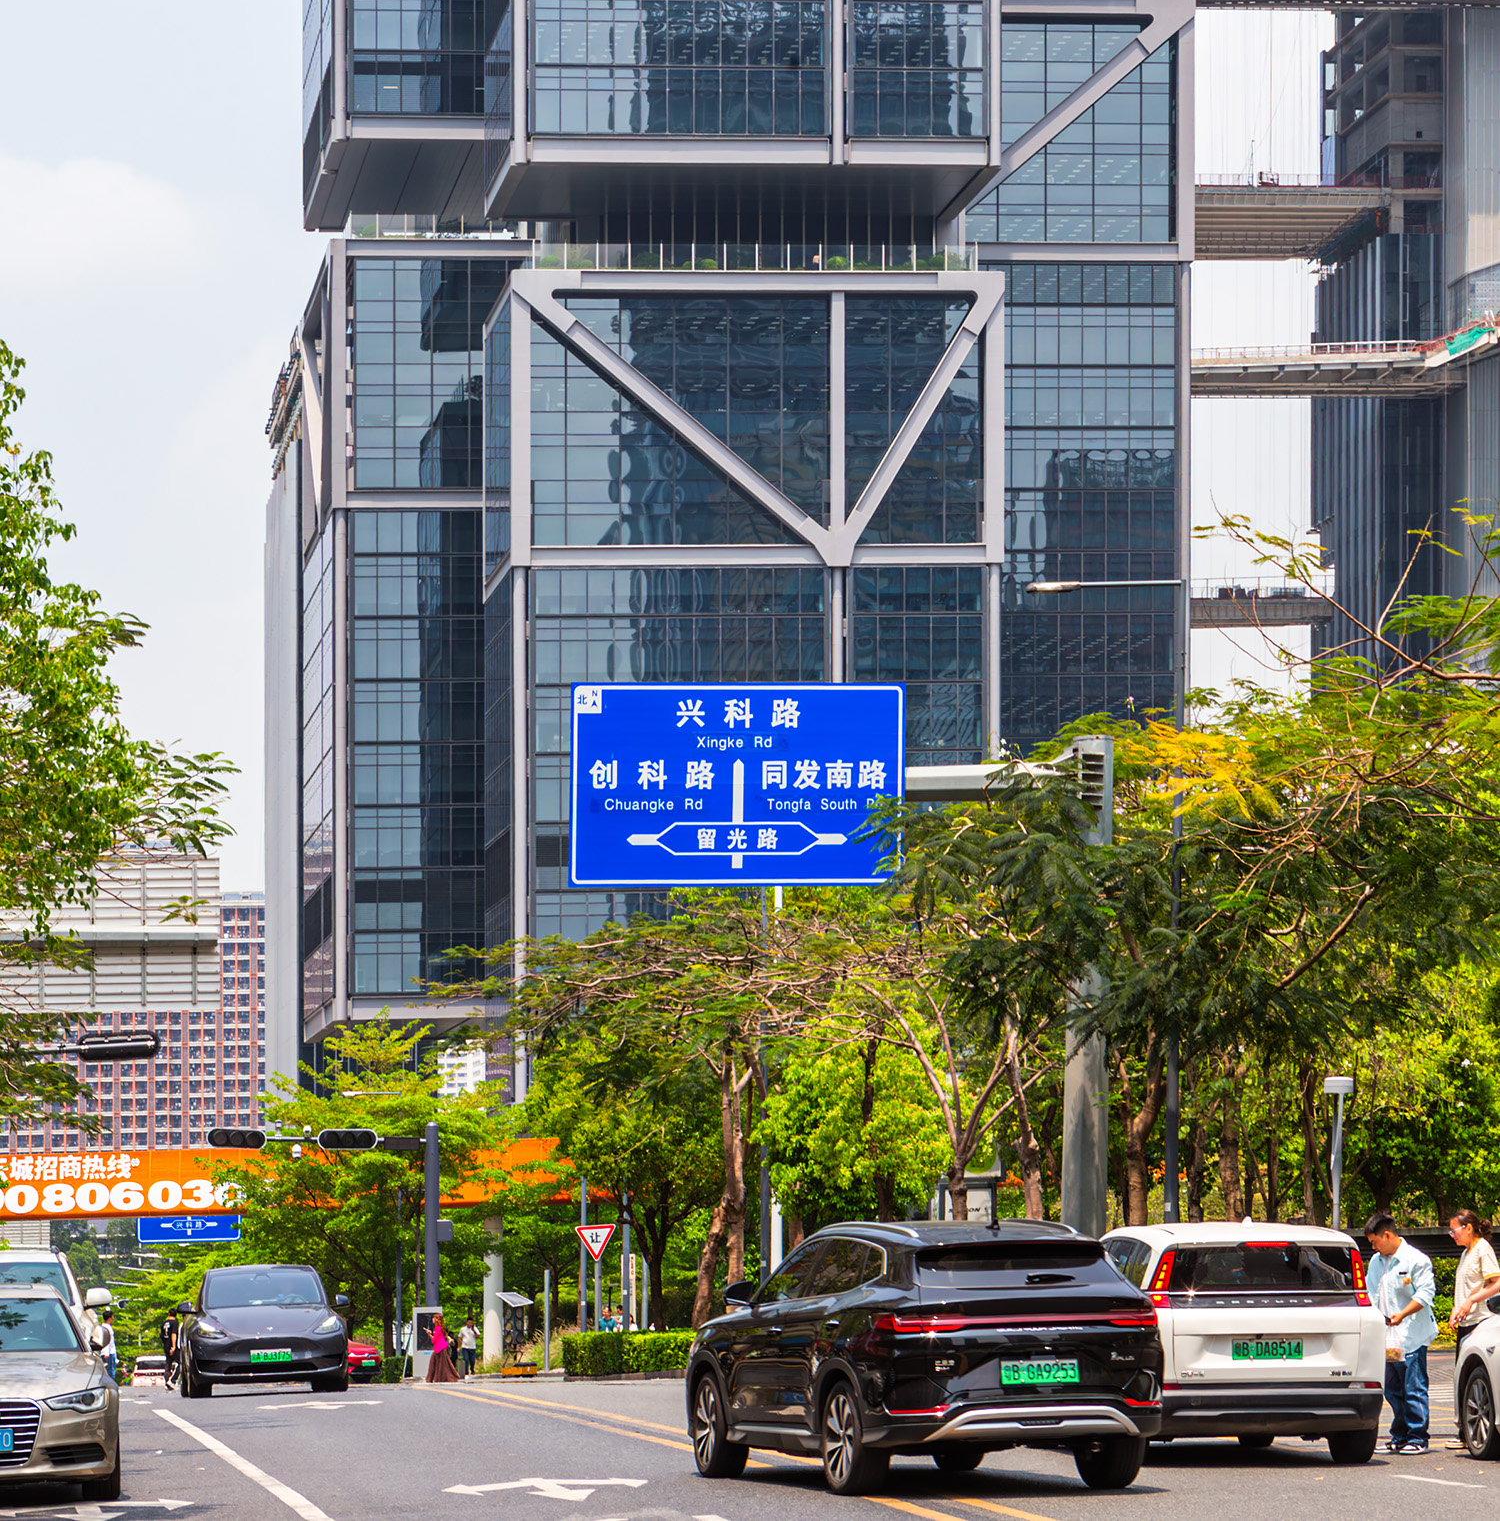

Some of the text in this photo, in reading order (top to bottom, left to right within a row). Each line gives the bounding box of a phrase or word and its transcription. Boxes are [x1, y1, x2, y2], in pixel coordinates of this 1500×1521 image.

[577, 694, 588, 705] 北
[676, 698, 801, 729] 兴科路
[697, 736, 773, 751] Xingke Rd
[589, 759, 715, 790] 创科路
[761, 760, 888, 790] 同发南路
[604, 798, 703, 813] Chuangke Rd
[767, 798, 811, 813] Tongfa
[820, 798, 857, 810] South
[697, 828, 779, 850] 留光路
[589, 1232, 602, 1244] 让
